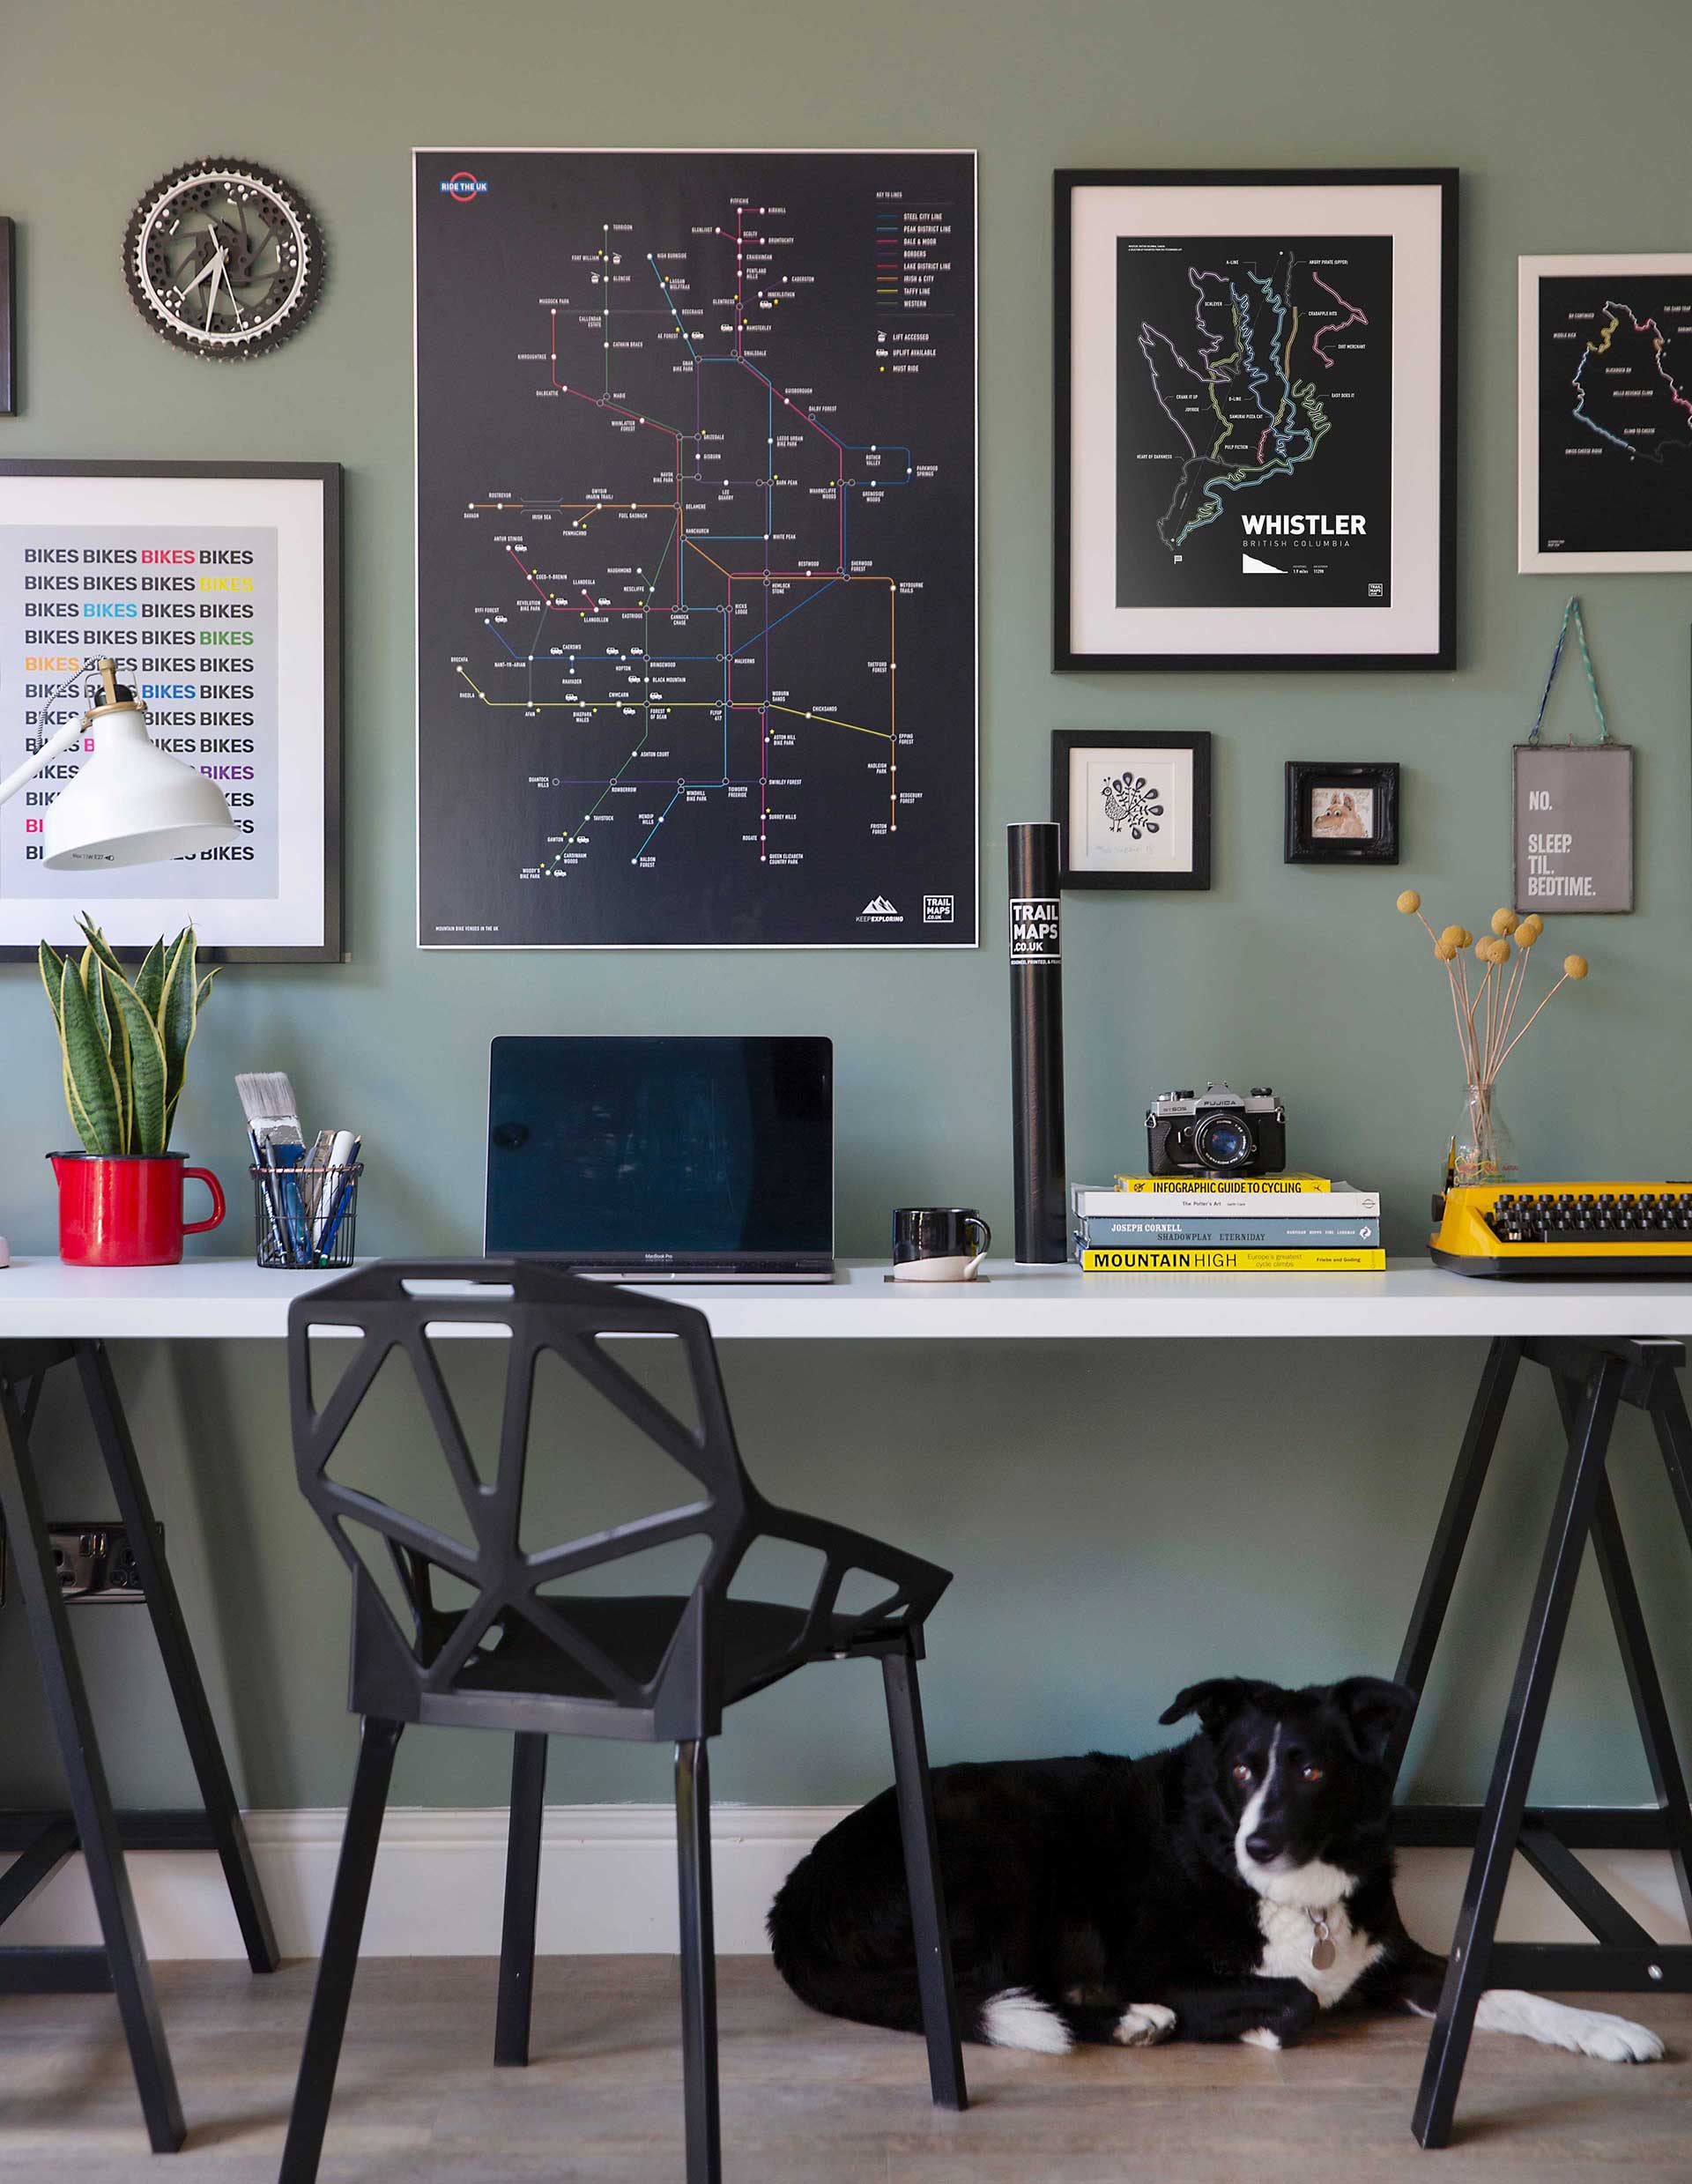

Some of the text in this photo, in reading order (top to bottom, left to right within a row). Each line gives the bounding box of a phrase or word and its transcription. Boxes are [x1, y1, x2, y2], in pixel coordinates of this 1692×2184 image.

[1241, 515, 1367, 535] WHISTLER
[26, 549, 253, 564] BIKES BIKES BIKES BIKES
[26, 576, 253, 591] BIKES BIKES BIKES BIKES
[26, 604, 253, 618] BIKES BIKES BIKES BIKES
[26, 630, 254, 645] BIKES BIKES BIKES BIKES
[26, 657, 80, 672] BIKES
[142, 657, 197, 672] BIKES
[199, 658, 254, 672] BIKES
[26, 684, 80, 698] BIKES
[142, 685, 197, 699] BIKES
[199, 685, 254, 700] BIKES
[144, 711, 254, 726] BIKES BIKES
[200, 739, 254, 753] BIKES
[33, 765, 80, 779] IKES
[1529, 791, 1553, 811] NO.
[1528, 834, 1572, 853] SLEEP.
[1528, 855, 1555, 875] TIL.
[1528, 877, 1596, 896] BEDTIME.
[1013, 904, 1058, 921] TRAIL
[1013, 924, 1058, 940] MAPS
[1013, 941, 1043, 952] .CO.UK
[1153, 1182, 1302, 1193] INFOGRAPHIC GUIDE TO CYCLING
[1095, 1254, 1236, 1267] MOUNTAIN HIGH
